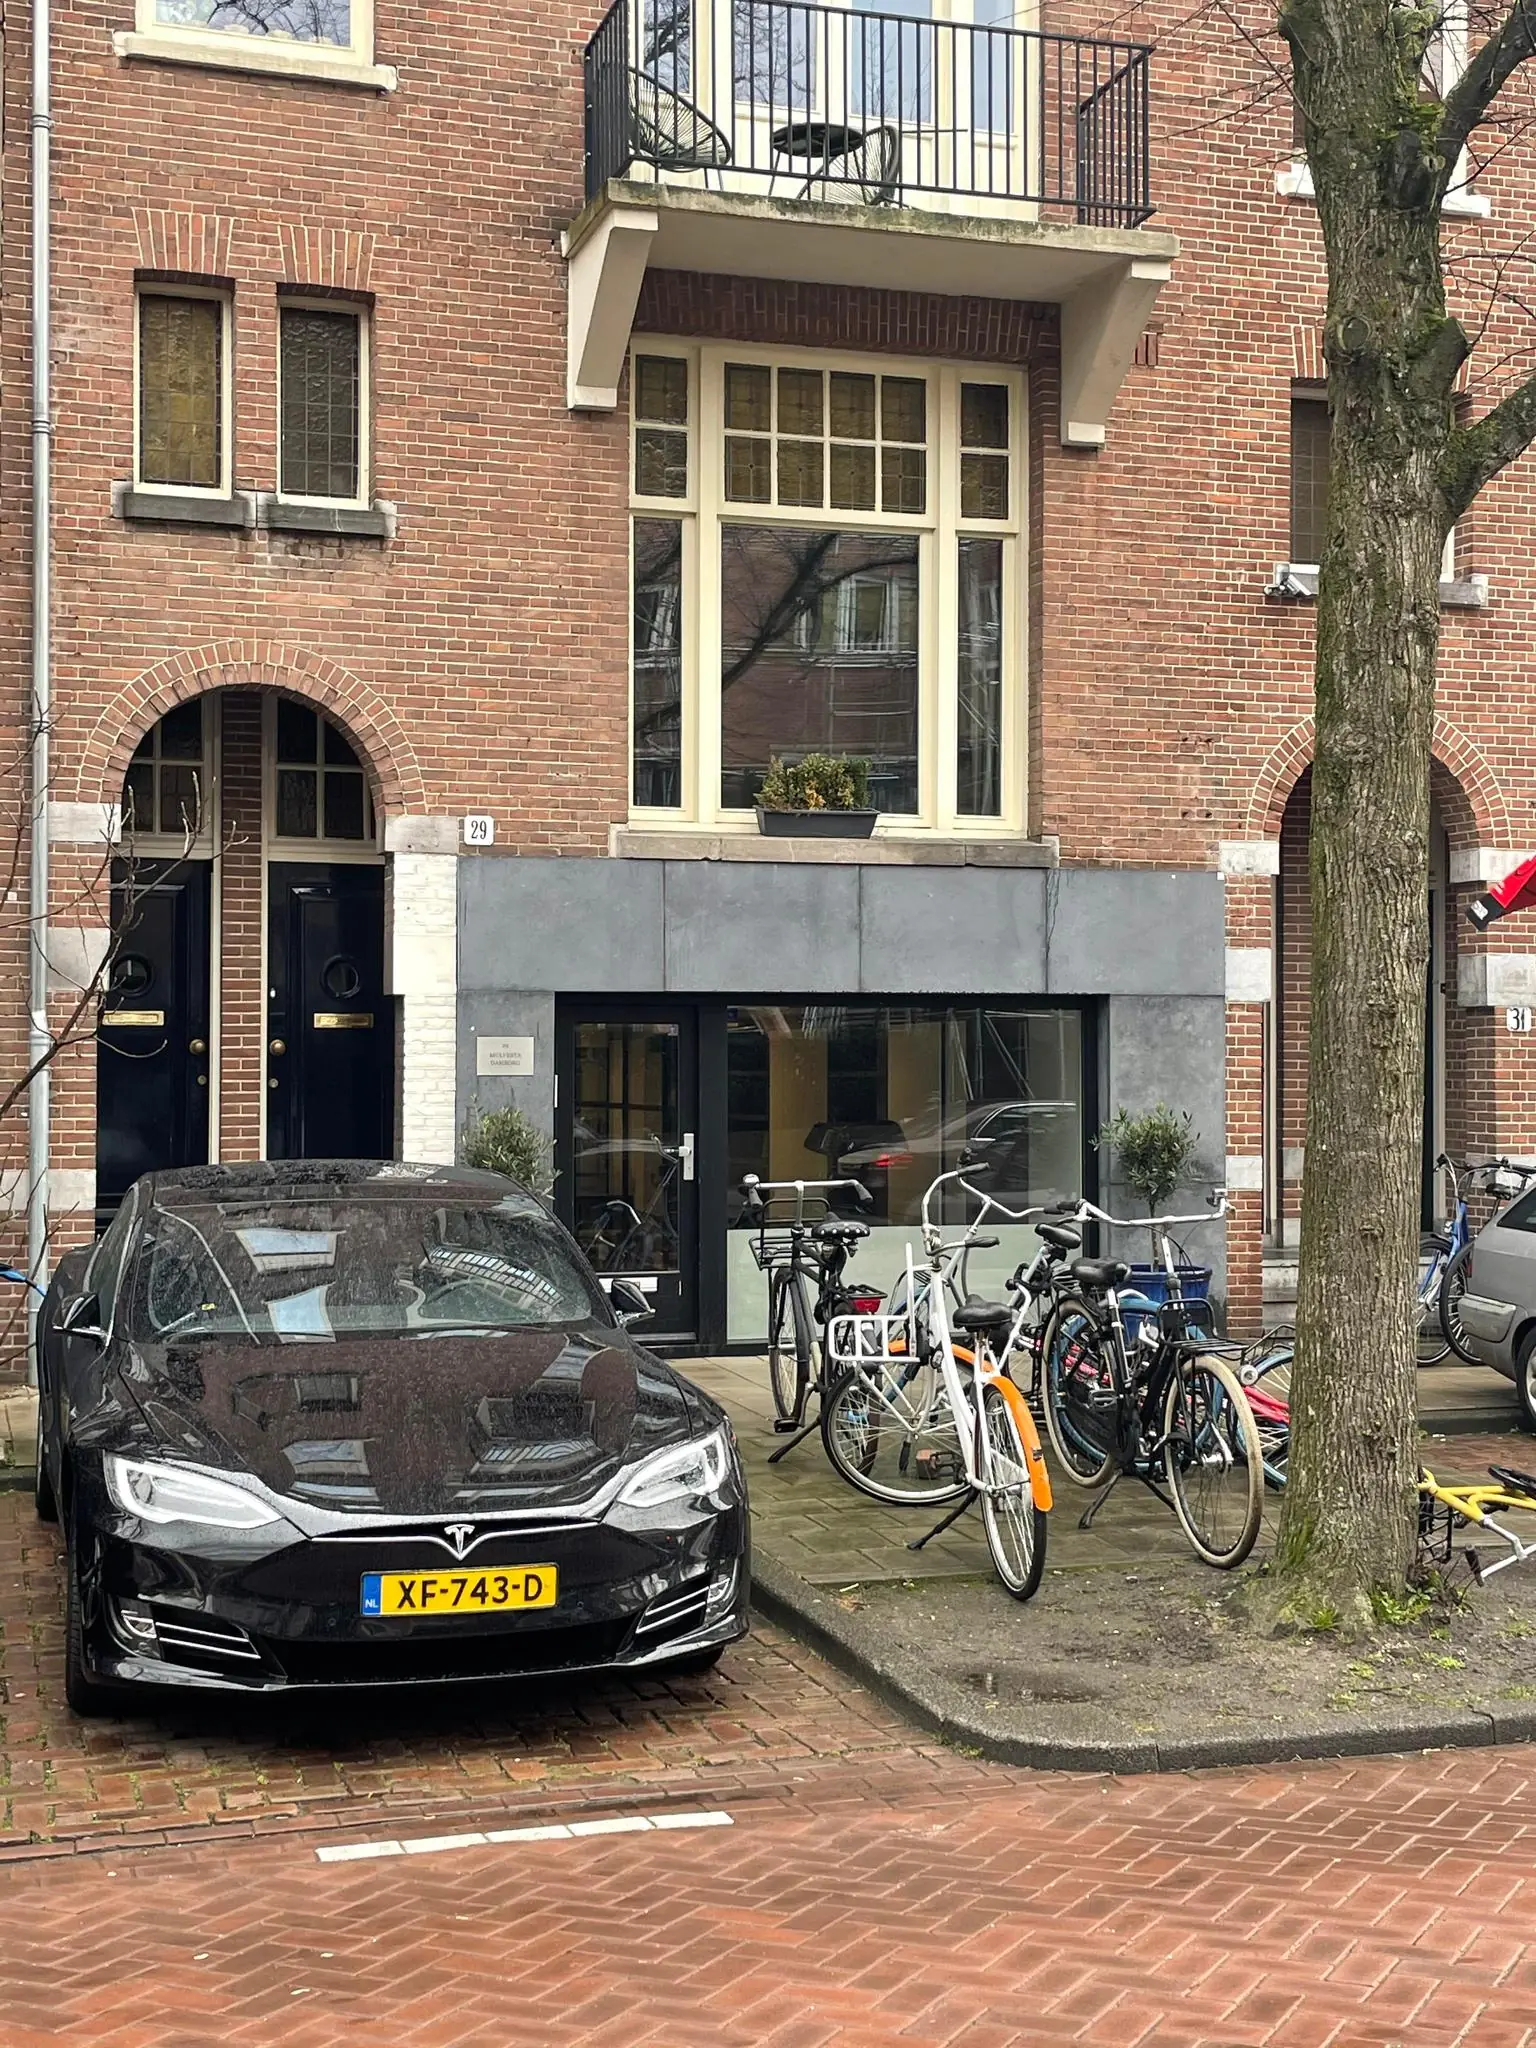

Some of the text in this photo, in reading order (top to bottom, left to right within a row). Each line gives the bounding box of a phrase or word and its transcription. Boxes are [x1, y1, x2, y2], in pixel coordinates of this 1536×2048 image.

[471, 820, 487, 840] 29
[1510, 1007, 1525, 1030] 31
[397, 1574, 543, 1609] XF-743-D
[365, 1599, 378, 1608] NL
